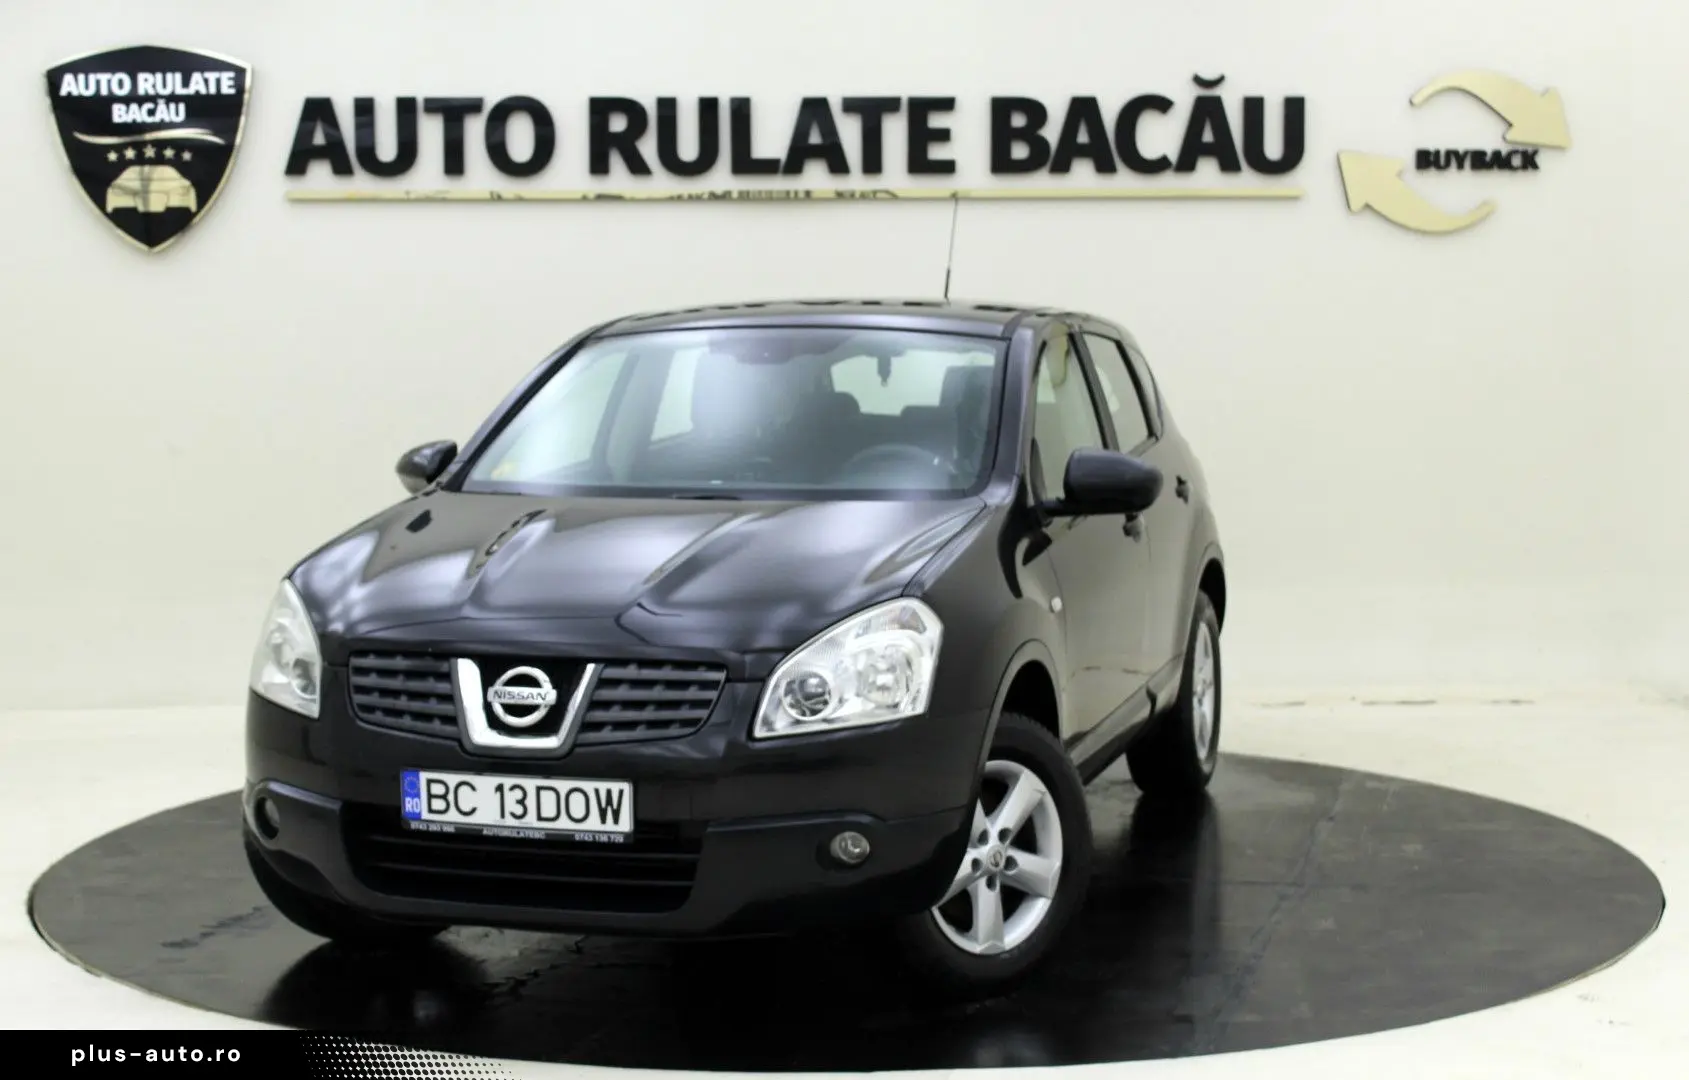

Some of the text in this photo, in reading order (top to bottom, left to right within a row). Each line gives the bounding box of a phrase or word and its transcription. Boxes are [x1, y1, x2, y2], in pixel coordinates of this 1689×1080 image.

[60, 71, 236, 97] AUTO RULATE
[111, 98, 187, 124] BACĂU
[285, 73, 1306, 177] AUTO RULATE BACĂU
[1415, 149, 1540, 172] BUYBACK
[493, 690, 547, 701] NISSAN
[404, 797, 420, 813] RO
[426, 778, 477, 817] BC
